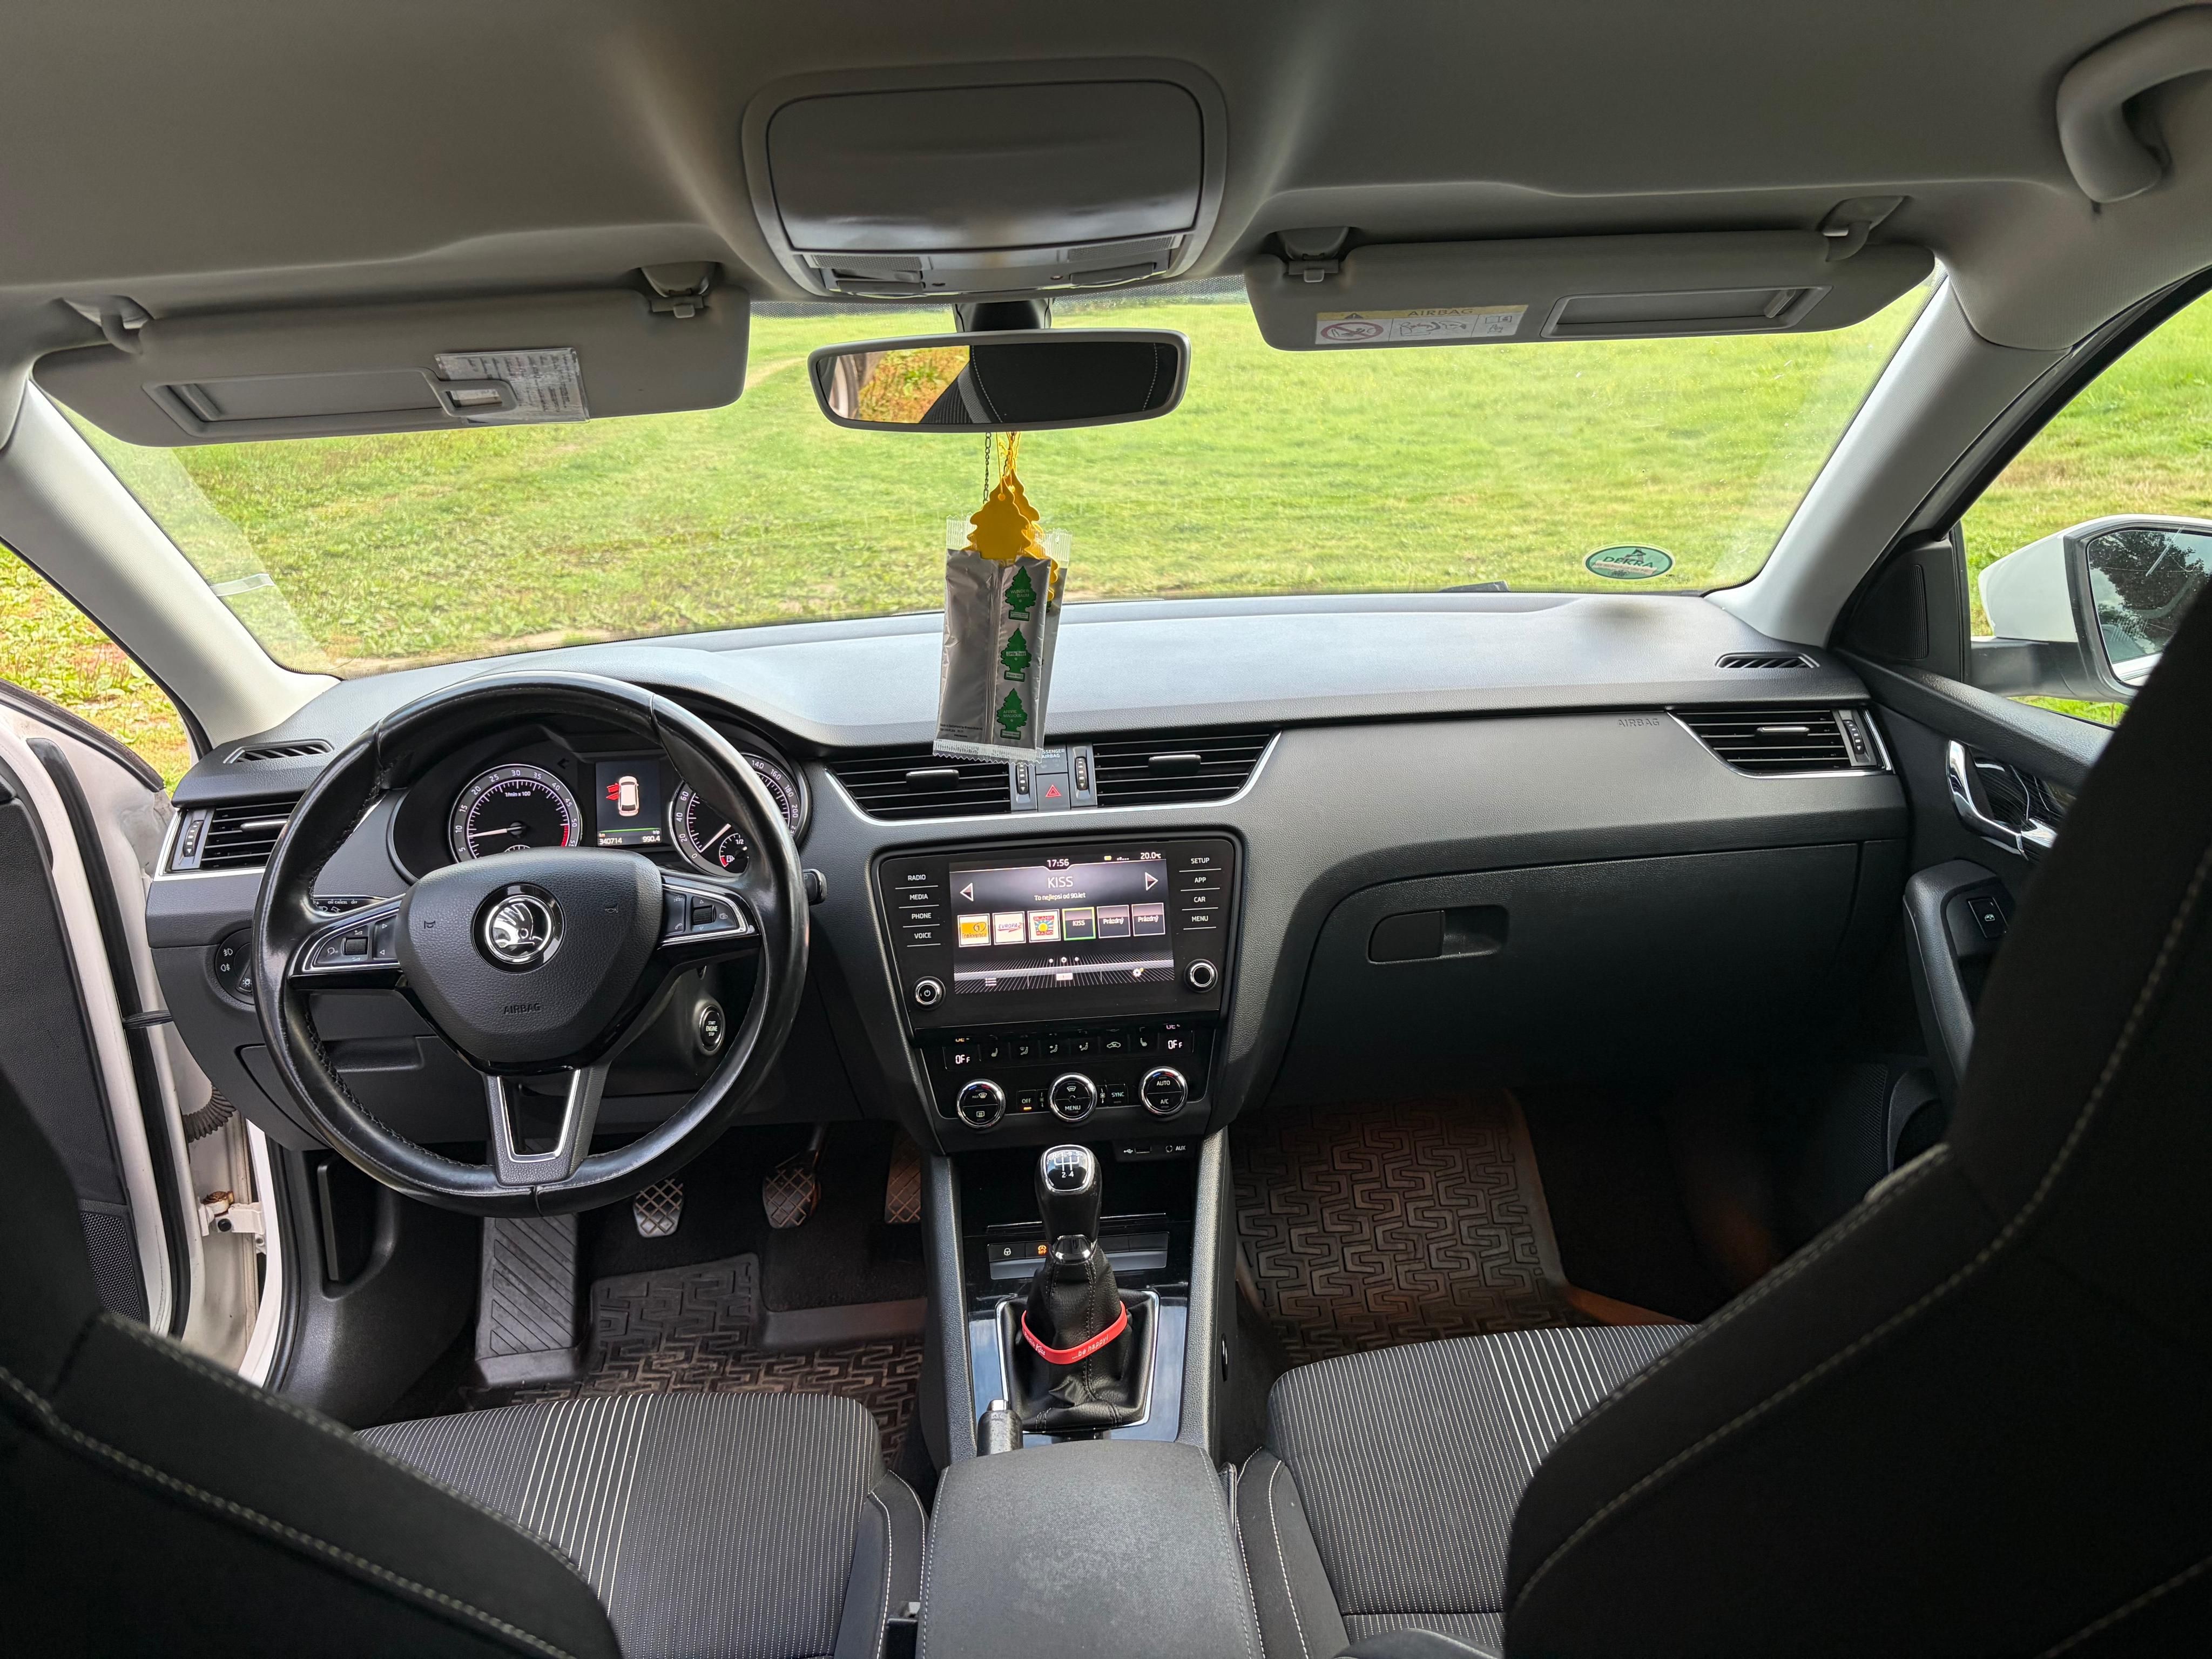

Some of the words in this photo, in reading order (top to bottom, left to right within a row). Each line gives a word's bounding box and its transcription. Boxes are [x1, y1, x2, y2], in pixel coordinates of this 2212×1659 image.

[1408, 308, 1473, 316] AIRBAG
[1603, 556, 1653, 568] DEKRA
[1618, 718, 1660, 727] AIRBAG
[752, 760, 764, 769] 140
[489, 774, 500, 783] 25
[770, 769, 781, 780] 160
[471, 786, 482, 795] 20
[552, 783, 561, 791] 40
[784, 784, 794, 797] 180
[680, 791, 689, 801] 60
[565, 798, 572, 807] 45
[459, 804, 468, 813] 15
[676, 813, 683, 822] 40
[571, 818, 577, 827] 50
[455, 825, 463, 833] 10
[679, 833, 687, 842] 20
[1047, 859, 1069, 867] 17:56
[1048, 876, 1074, 888] KISS
[503, 1003, 541, 1014] AIRBAG
[1088, 1335, 1109, 1352] happy!
